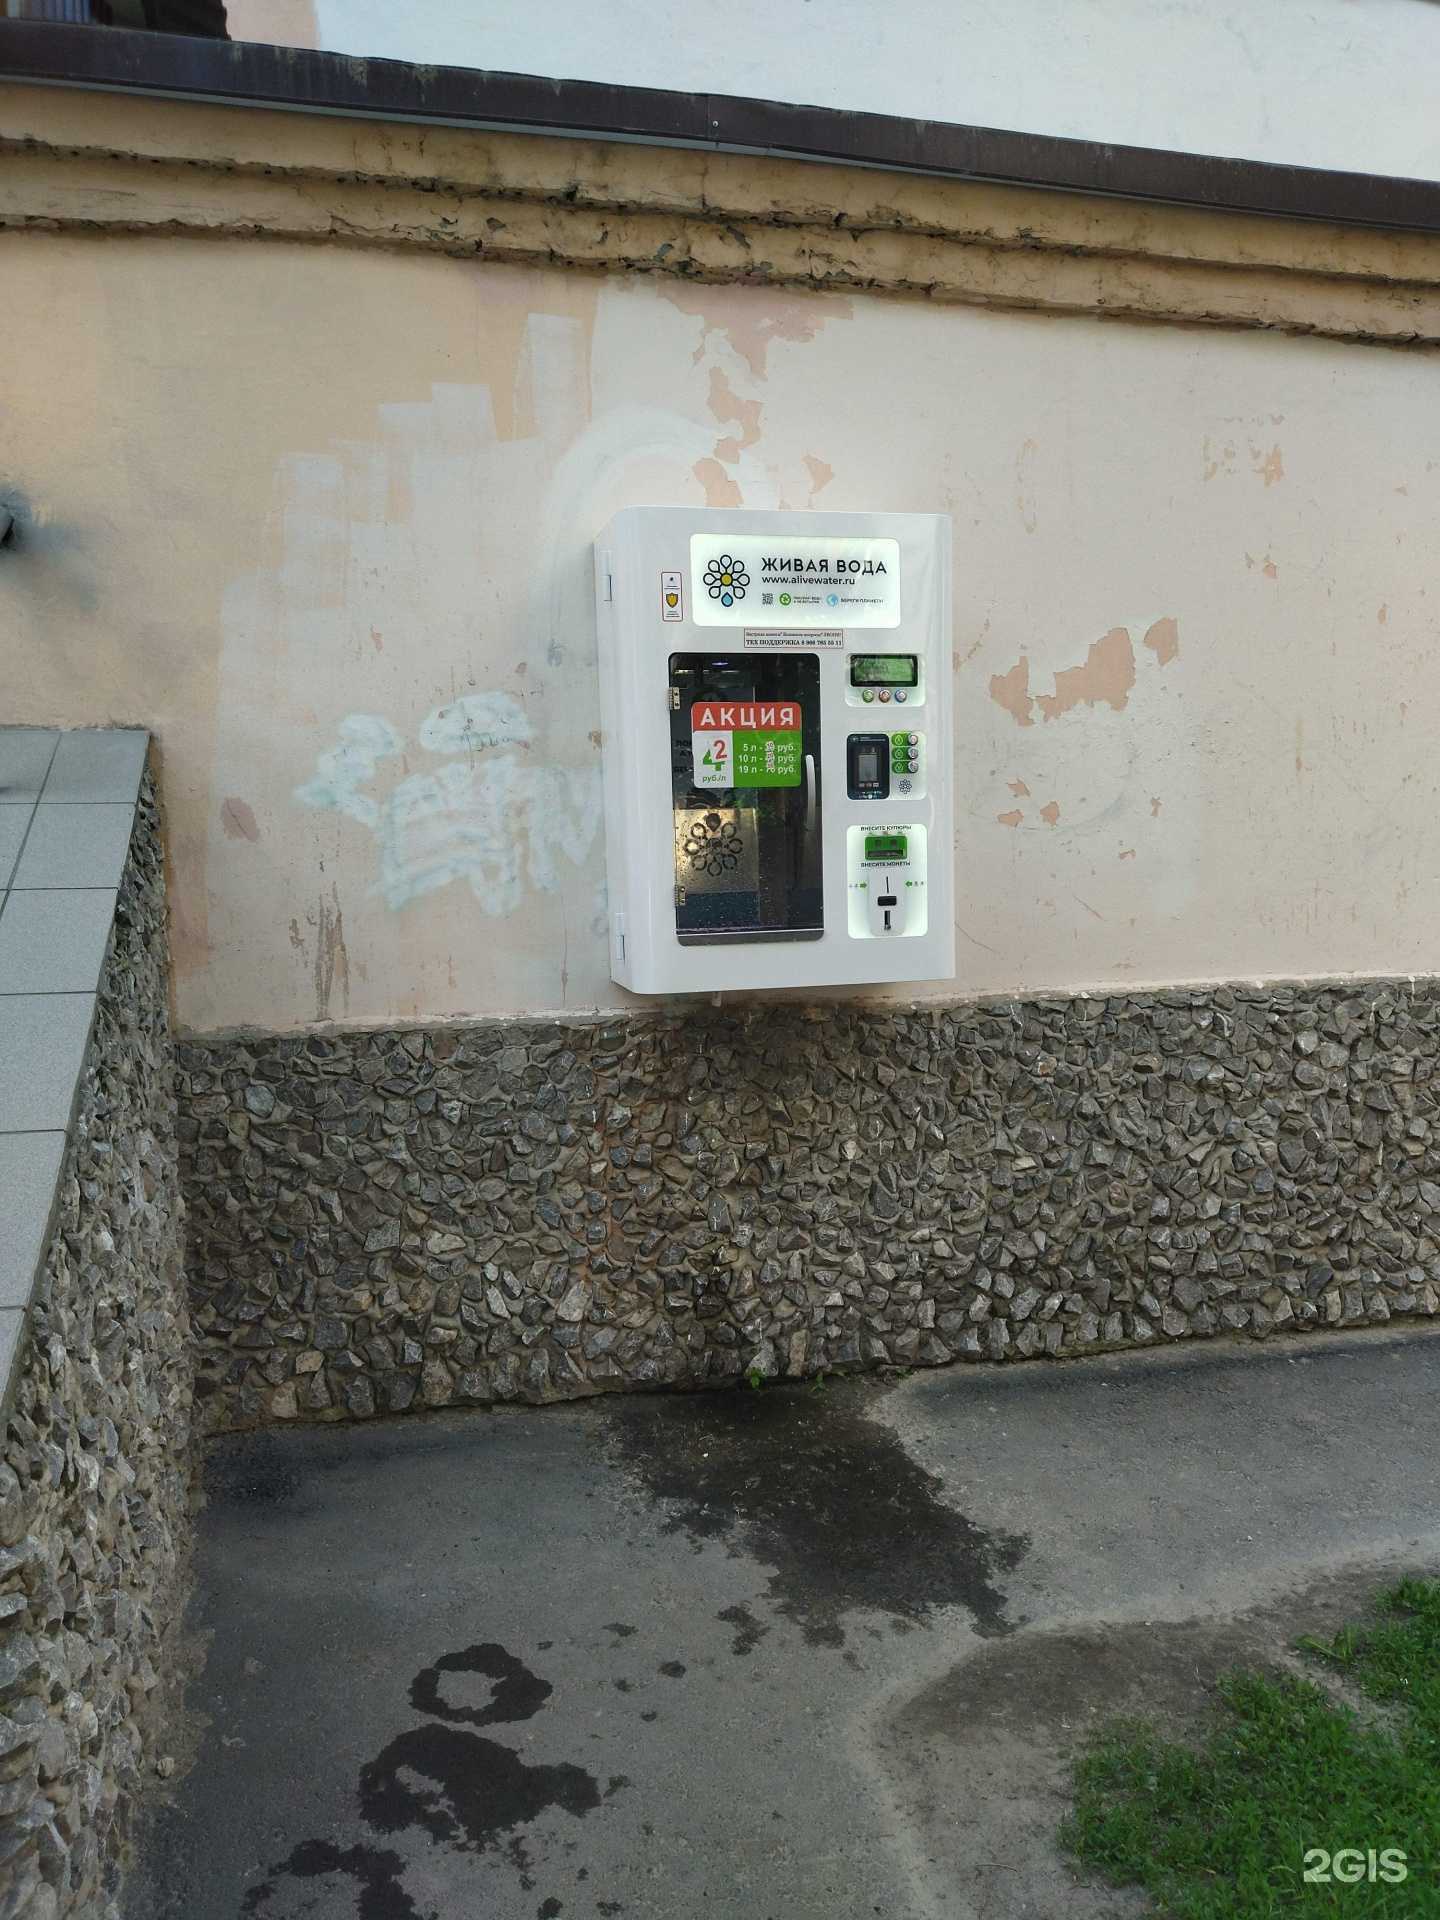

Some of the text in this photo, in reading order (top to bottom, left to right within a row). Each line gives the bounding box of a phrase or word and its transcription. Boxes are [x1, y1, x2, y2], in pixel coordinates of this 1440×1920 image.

[761, 557, 887, 575] ЖИВАЯ ВОДА
[762, 575, 855, 585] www.alivewater.ru
[700, 707, 794, 729] АКЦИЯ
[713, 739, 728, 760] 2
[777, 744, 796, 753] руб.
[739, 755, 748, 763] 10
[777, 754, 796, 765] руб.
[777, 766, 796, 775] руб.
[702, 775, 726, 783] руб./л
